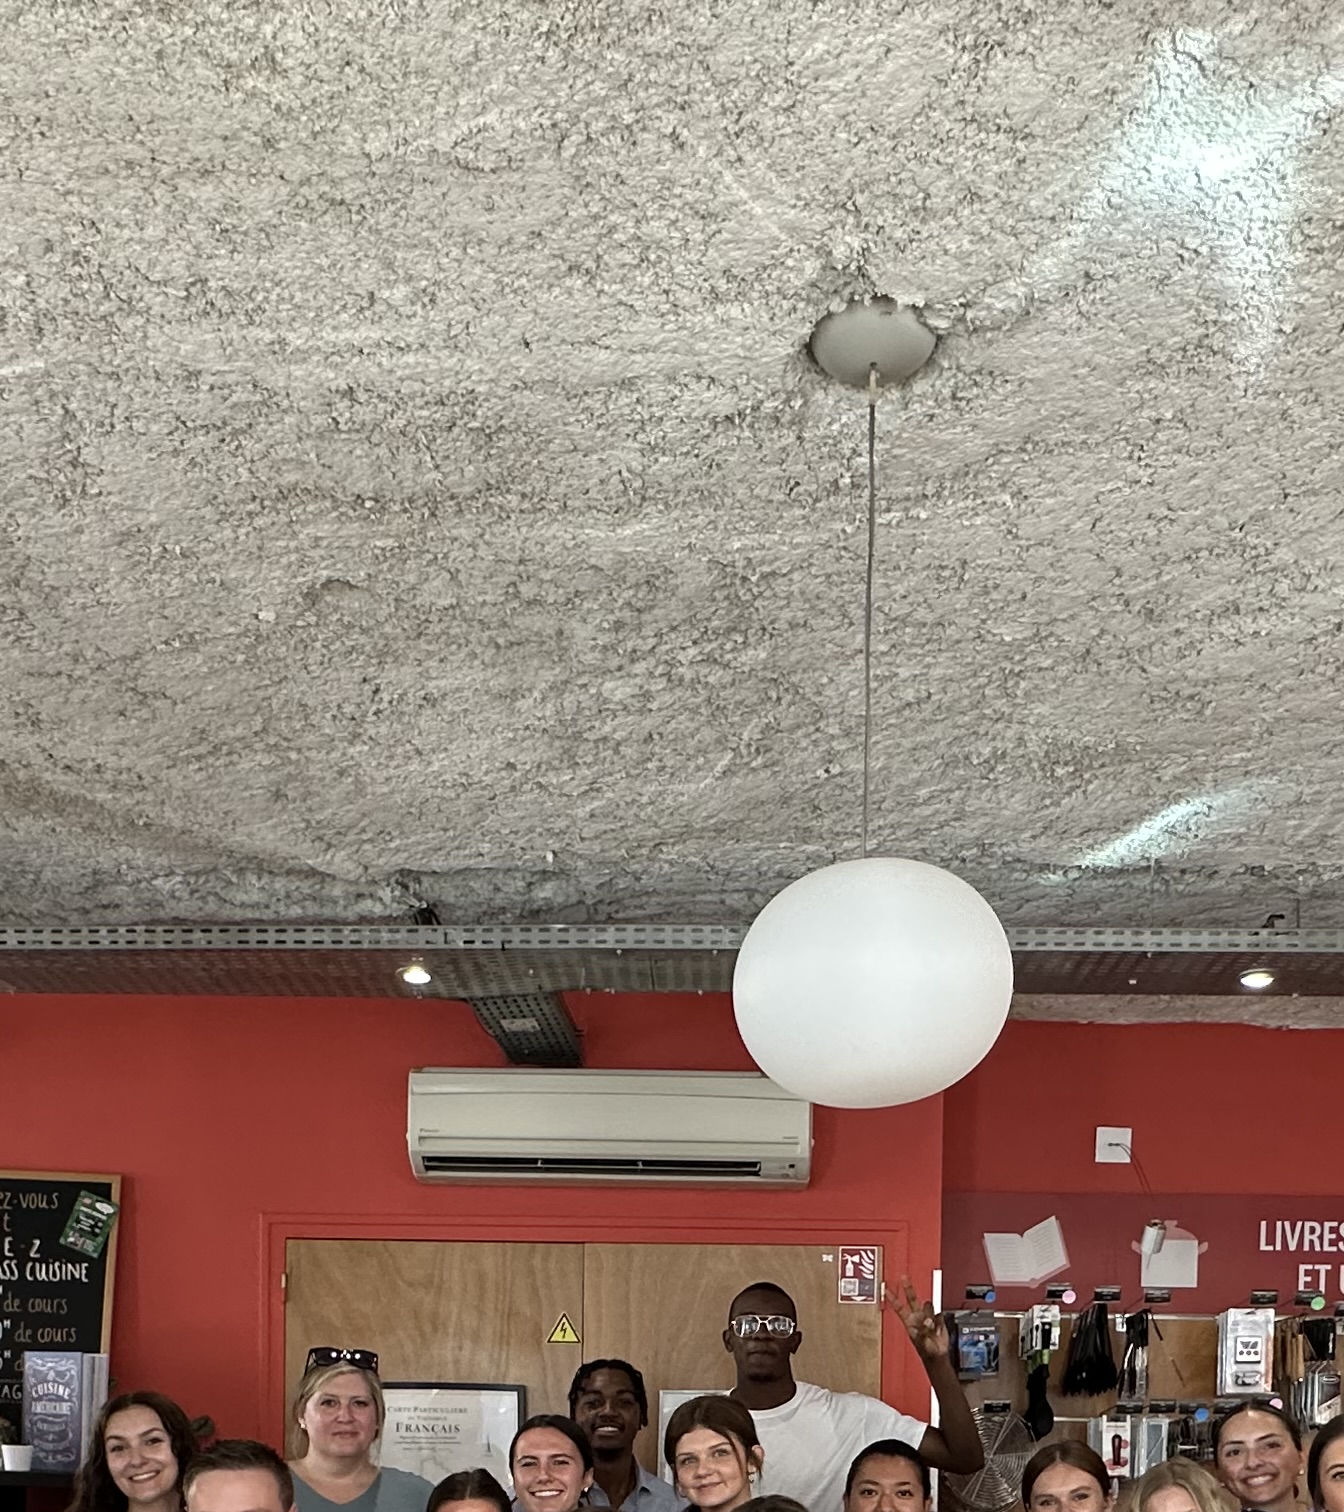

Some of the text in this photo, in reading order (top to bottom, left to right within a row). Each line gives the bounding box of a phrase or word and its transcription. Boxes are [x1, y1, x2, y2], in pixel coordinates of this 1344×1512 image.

[1297, 1264, 1332, 1294] ET
[3, 1291, 22, 1312] de
[28, 1298, 68, 1314] cours
[15, 1321, 33, 1342] de
[37, 1328, 77, 1343] cours
[31, 1382, 72, 1400] CUISINE
